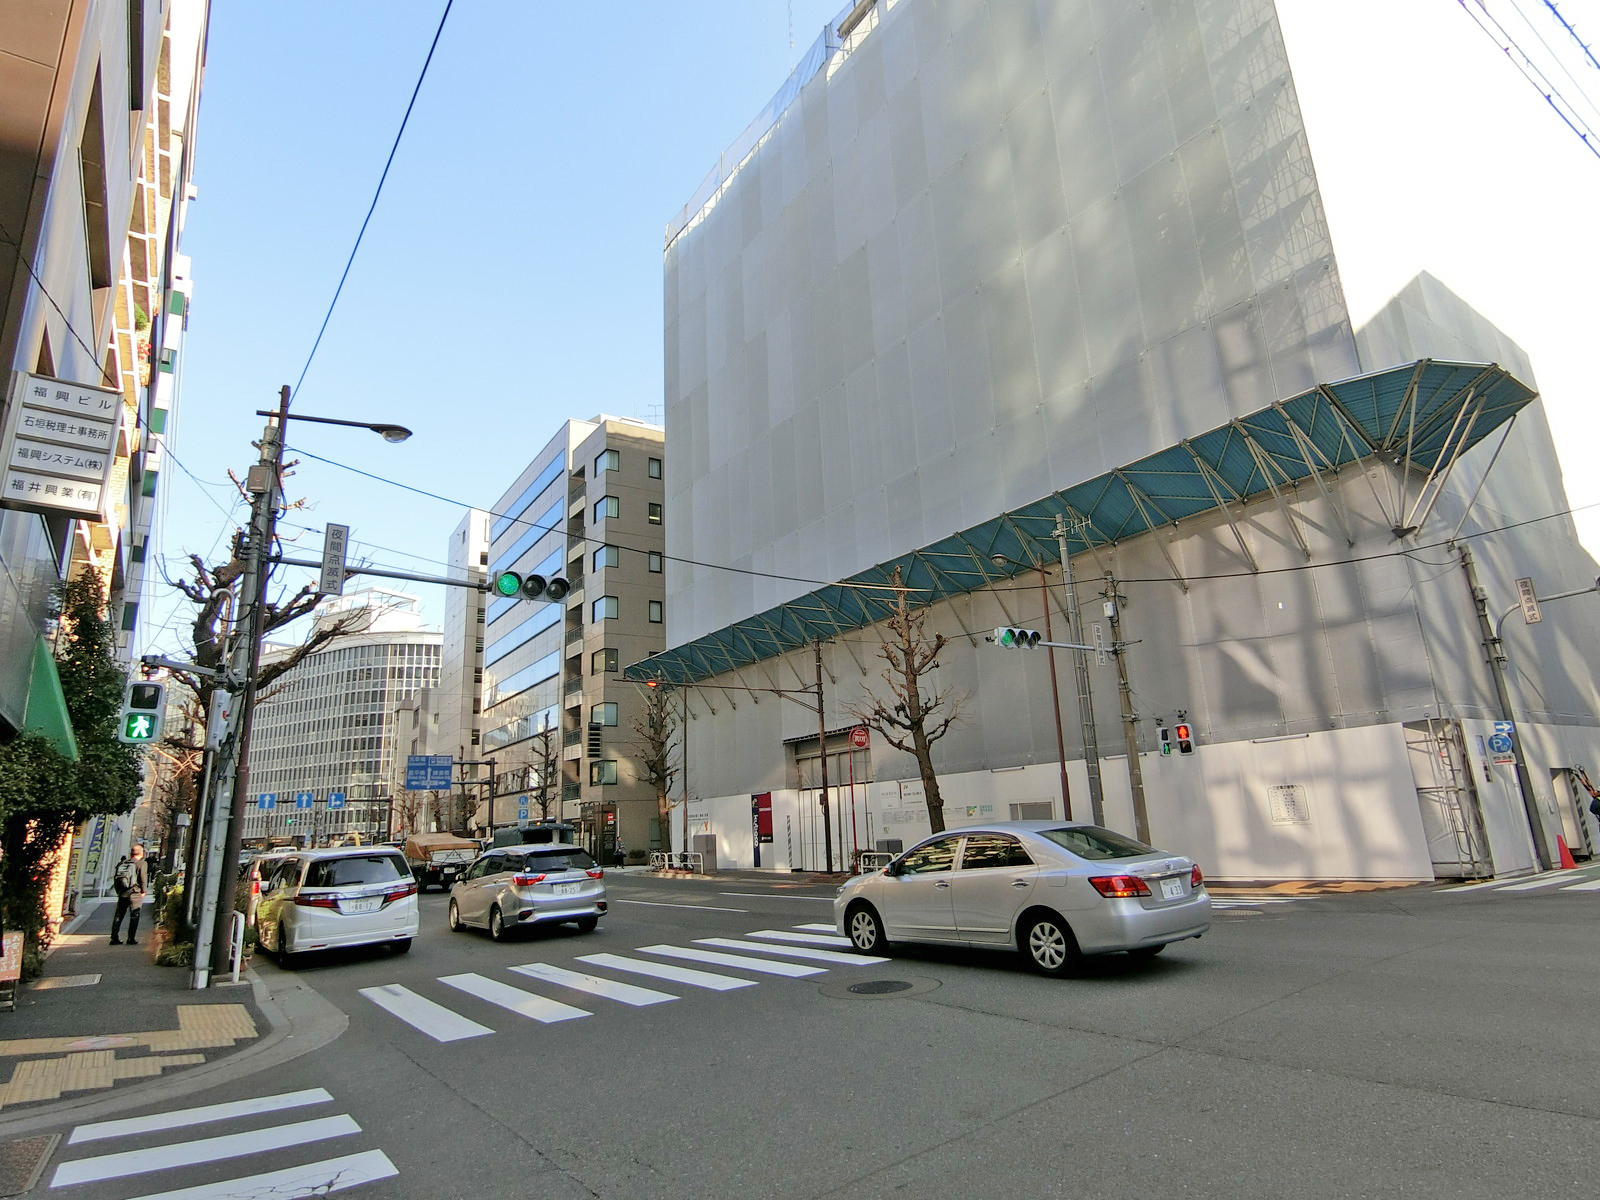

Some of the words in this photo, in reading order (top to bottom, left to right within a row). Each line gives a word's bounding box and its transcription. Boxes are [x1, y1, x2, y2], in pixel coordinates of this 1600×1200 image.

[33, 385, 112, 411] 福興ビル
[24, 415, 109, 441] 石垣税理士事務所
[17, 447, 103, 472] 福興システム(株)
[11, 478, 97, 502] 福井興業(有)
[326, 529, 343, 591] 夜間点滅式
